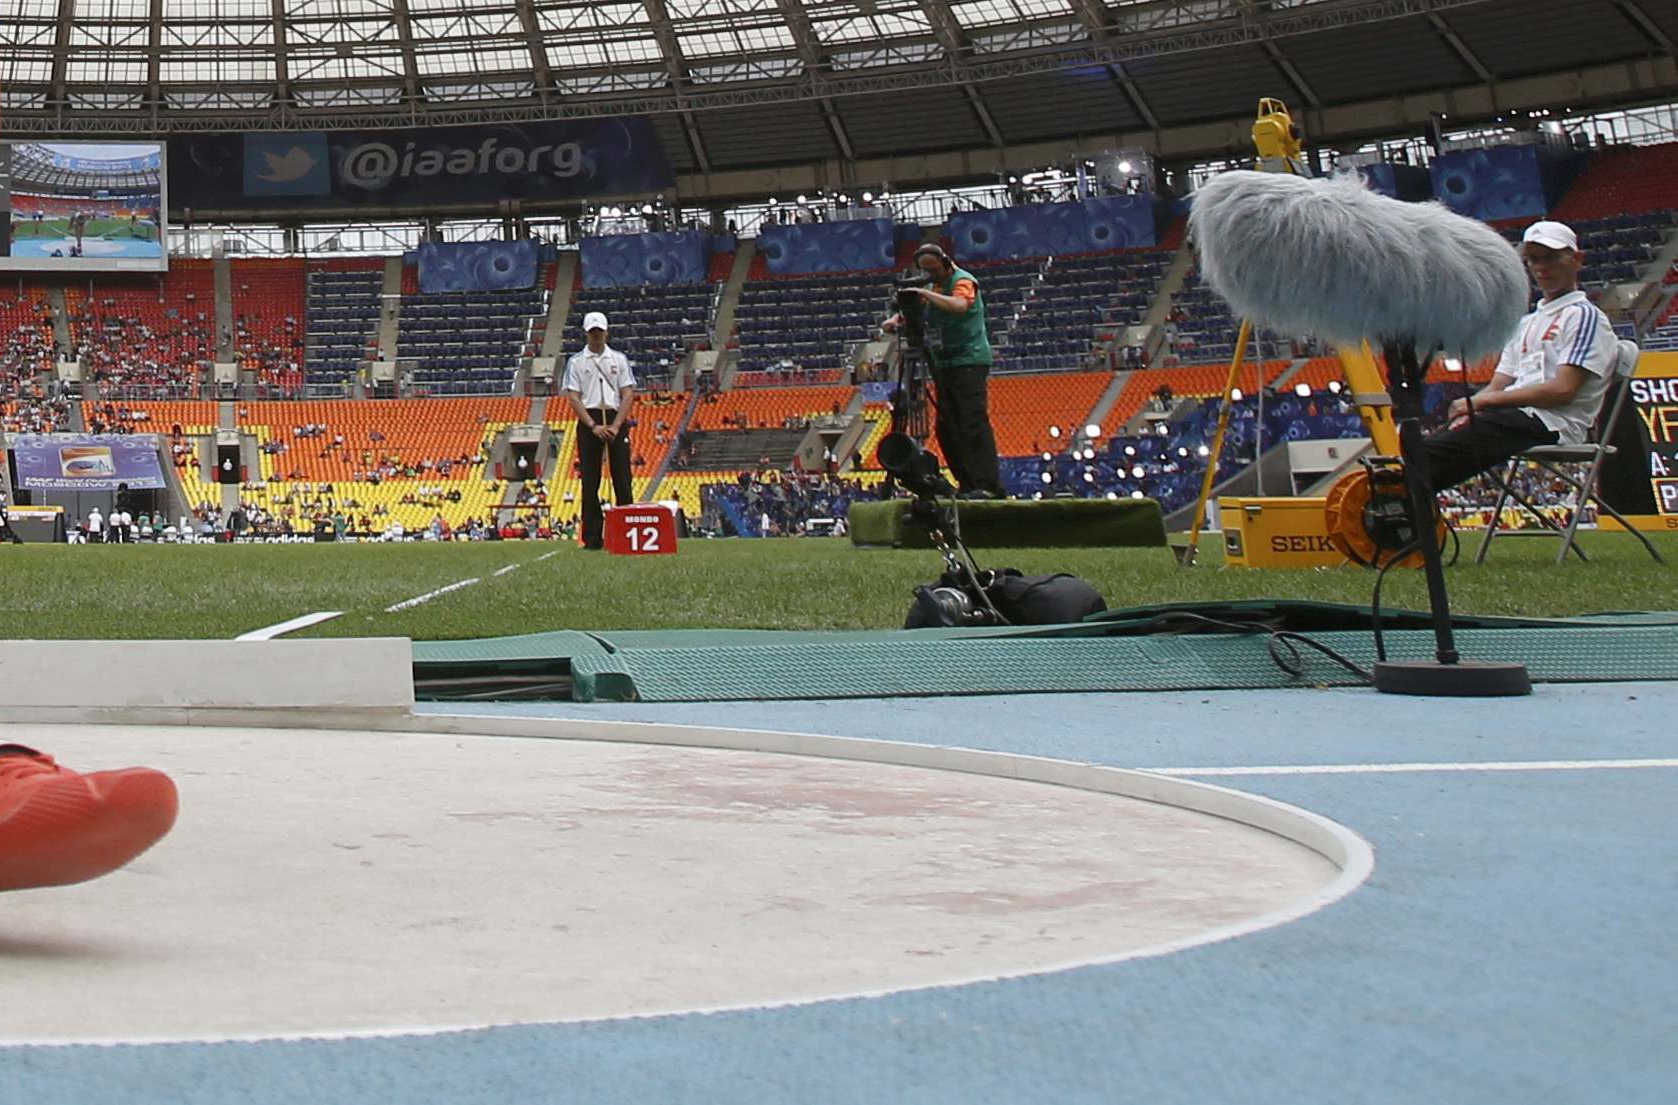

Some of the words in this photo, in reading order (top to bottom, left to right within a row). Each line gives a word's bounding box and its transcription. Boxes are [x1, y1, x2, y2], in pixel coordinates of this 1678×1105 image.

[342, 137, 584, 189] @iaaforg
[625, 515, 659, 523] MONDO
[625, 526, 659, 551] 12
[1270, 535, 1337, 552] SEIK
